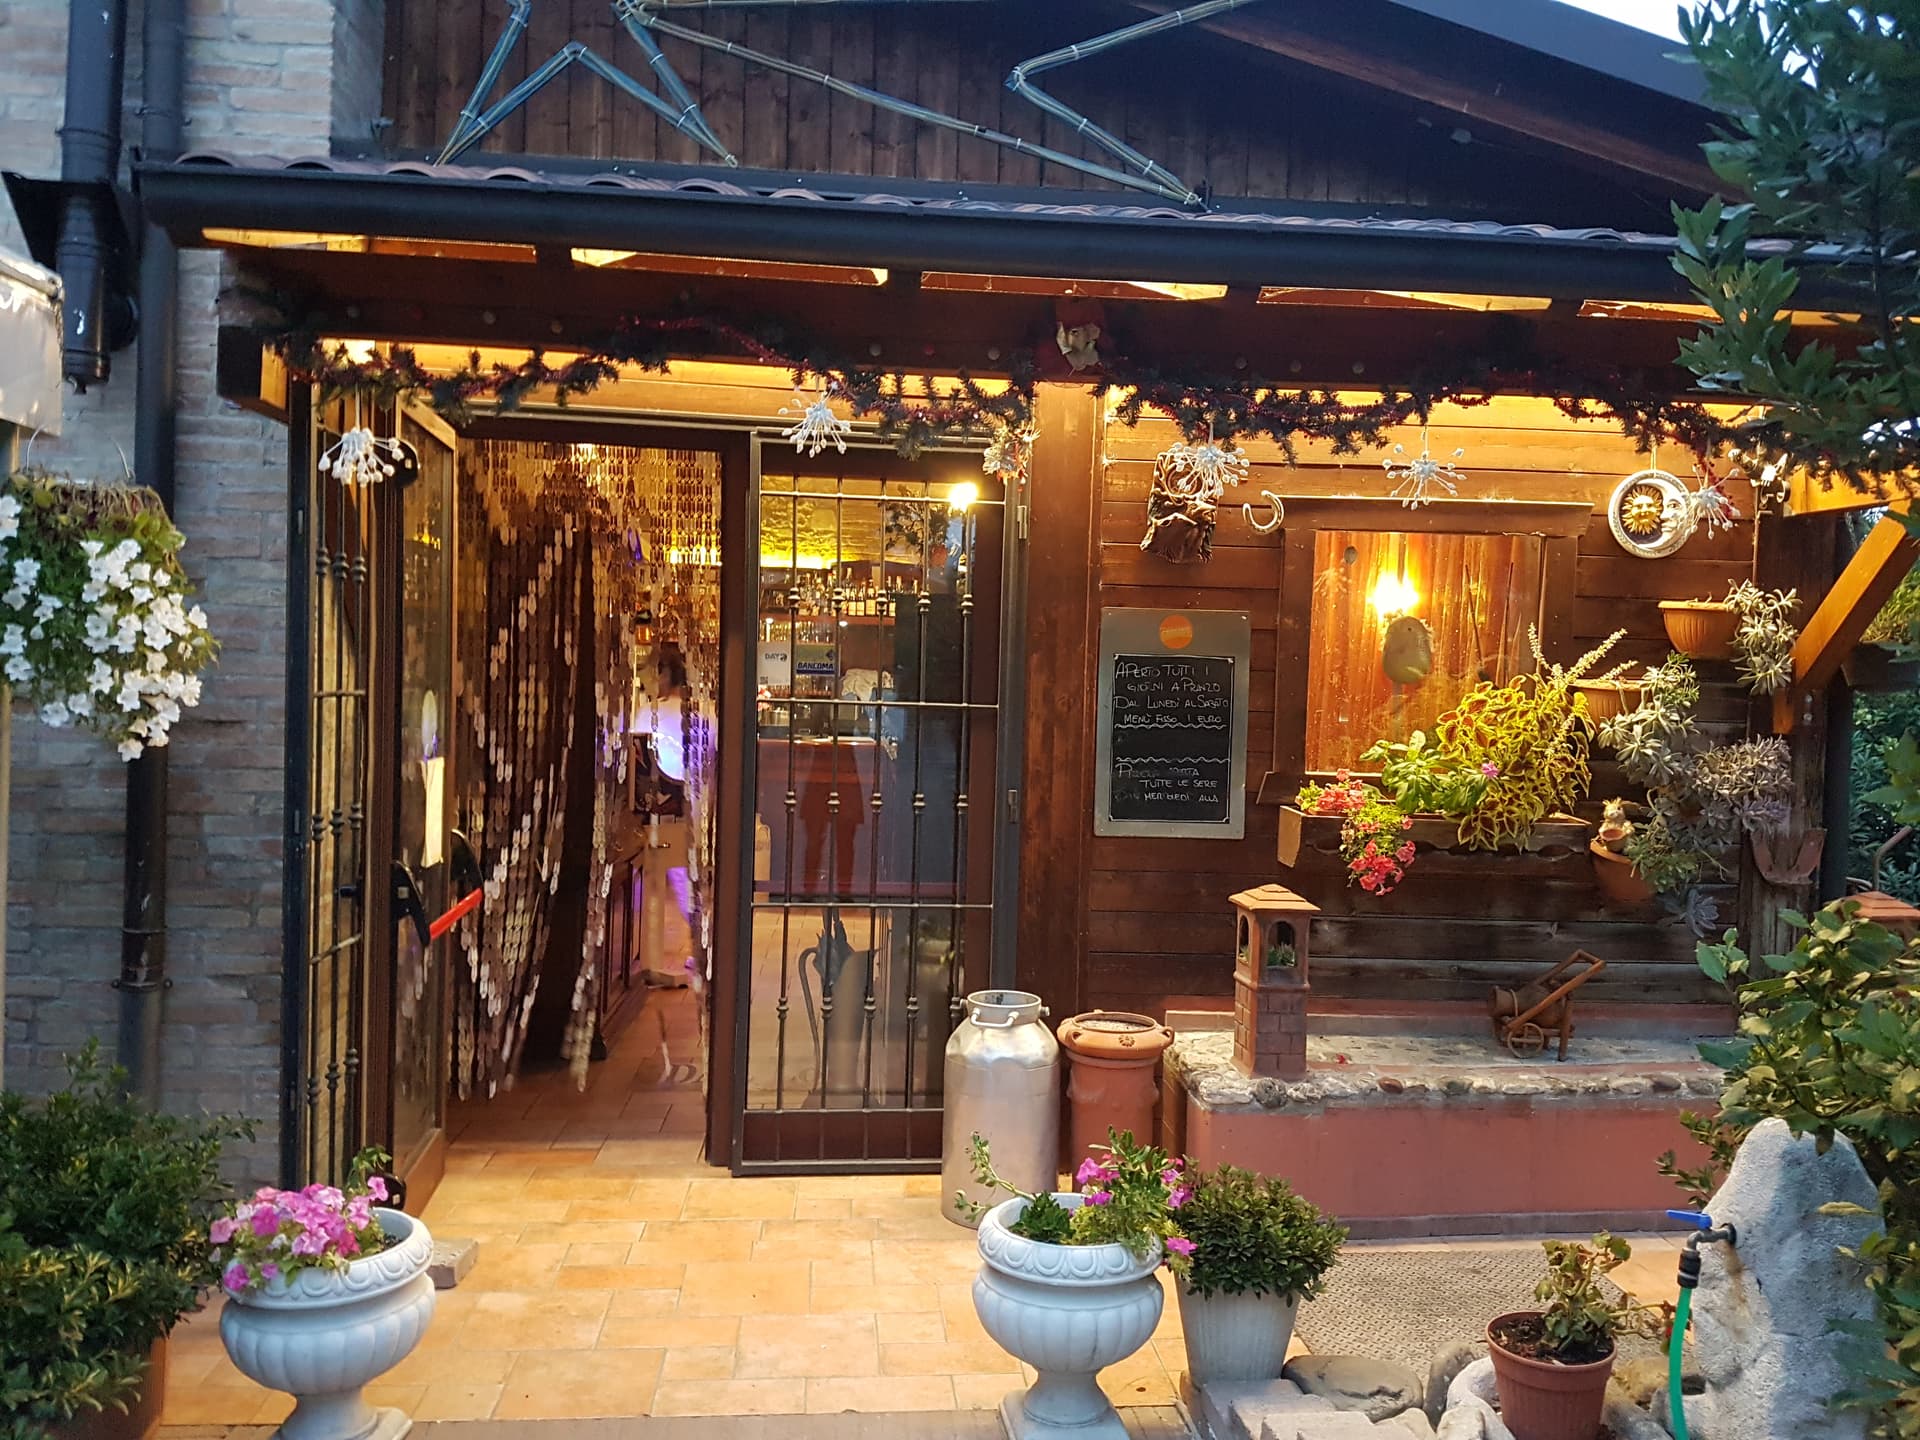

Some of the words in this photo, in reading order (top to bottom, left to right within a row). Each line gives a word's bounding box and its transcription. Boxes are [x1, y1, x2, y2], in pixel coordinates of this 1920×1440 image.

[1116, 662, 1160, 678] APERTO
[1161, 664, 1194, 677] TUTTI
[1171, 682, 1180, 692] A
[1180, 677, 1221, 692] PRANZO
[1114, 696, 1139, 709] DAL
[1184, 699, 1197, 708] AL
[1197, 694, 1229, 709] SABATO
[1156, 714, 1178, 723] FISSO
[1197, 715, 1222, 723] EURO
[1139, 779, 1172, 788] TUTTE
[1178, 779, 1189, 787] LE
[1193, 779, 1218, 788] SERE
